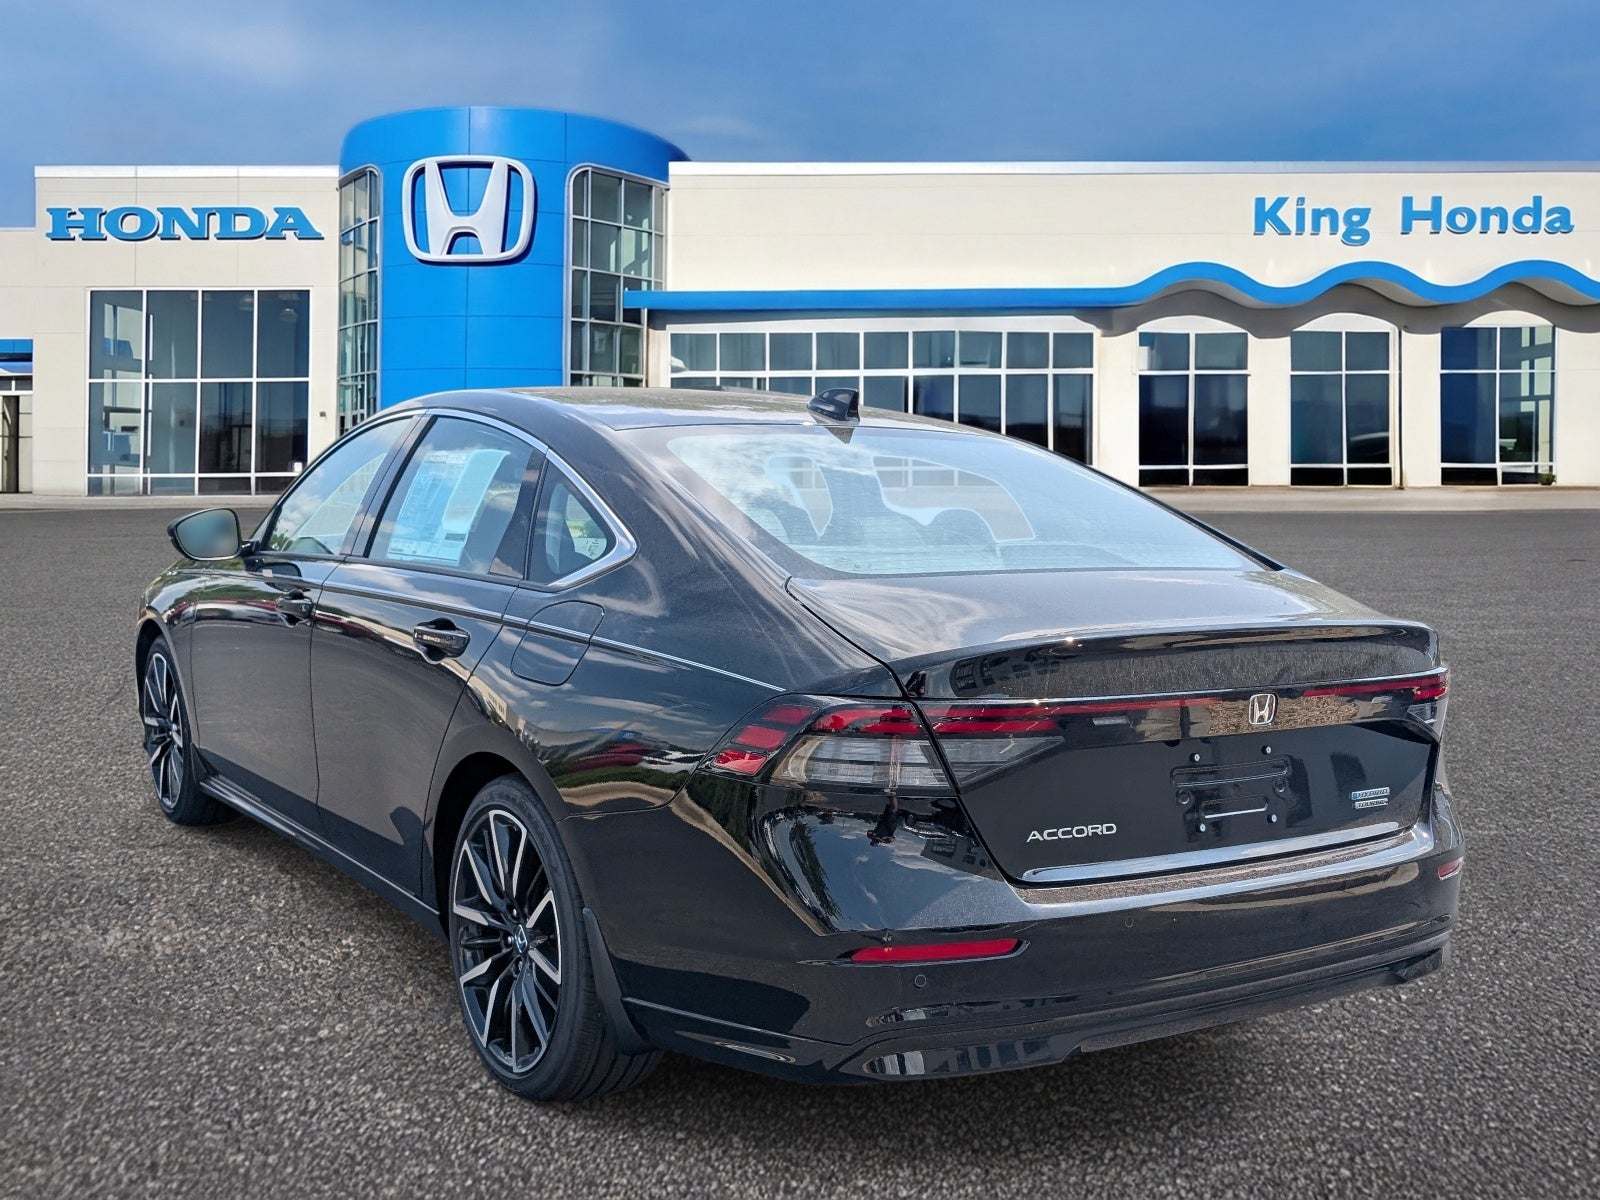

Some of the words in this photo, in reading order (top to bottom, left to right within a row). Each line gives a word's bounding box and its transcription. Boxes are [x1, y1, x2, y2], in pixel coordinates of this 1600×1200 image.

[45, 206, 324, 241] HONDA
[1253, 196, 1371, 246] King
[1400, 195, 1574, 234] Honda
[1026, 823, 1117, 843] ACCORD
